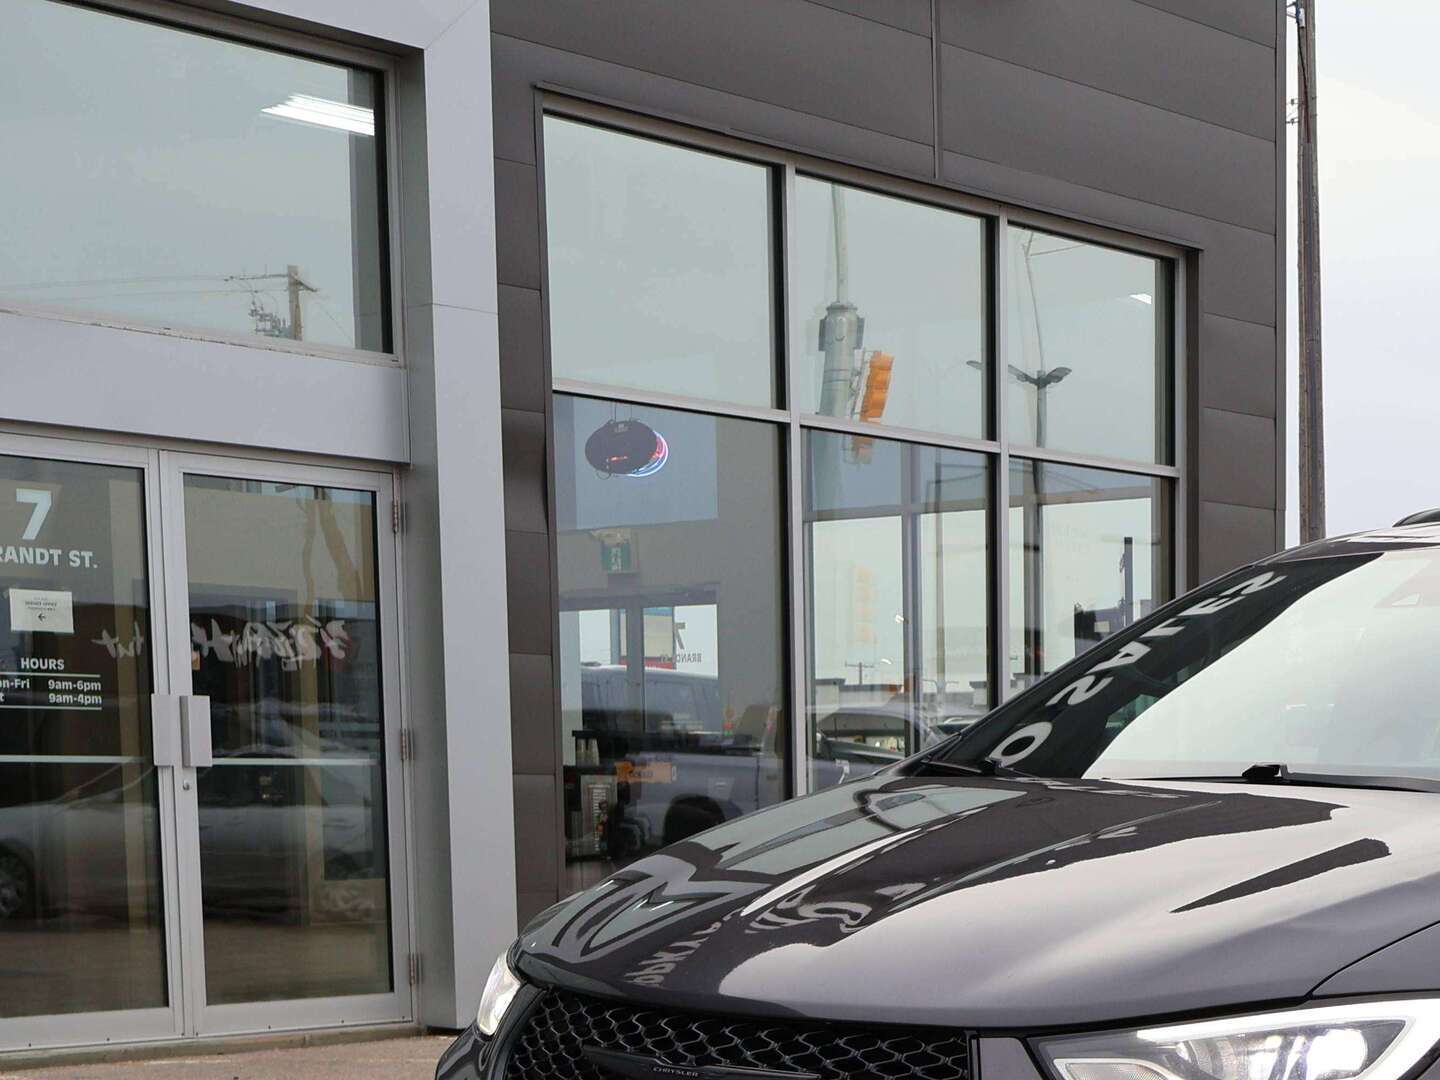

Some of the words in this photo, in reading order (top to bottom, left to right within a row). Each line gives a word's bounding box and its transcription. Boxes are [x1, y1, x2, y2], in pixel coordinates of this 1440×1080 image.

[16, 488, 52, 540] 7
[0, 545, 62, 567] ANDT
[68, 550, 98, 569] ST.
[20, 657, 65, 670] HOURS
[653, 1066, 699, 1078] CHRYSLER
